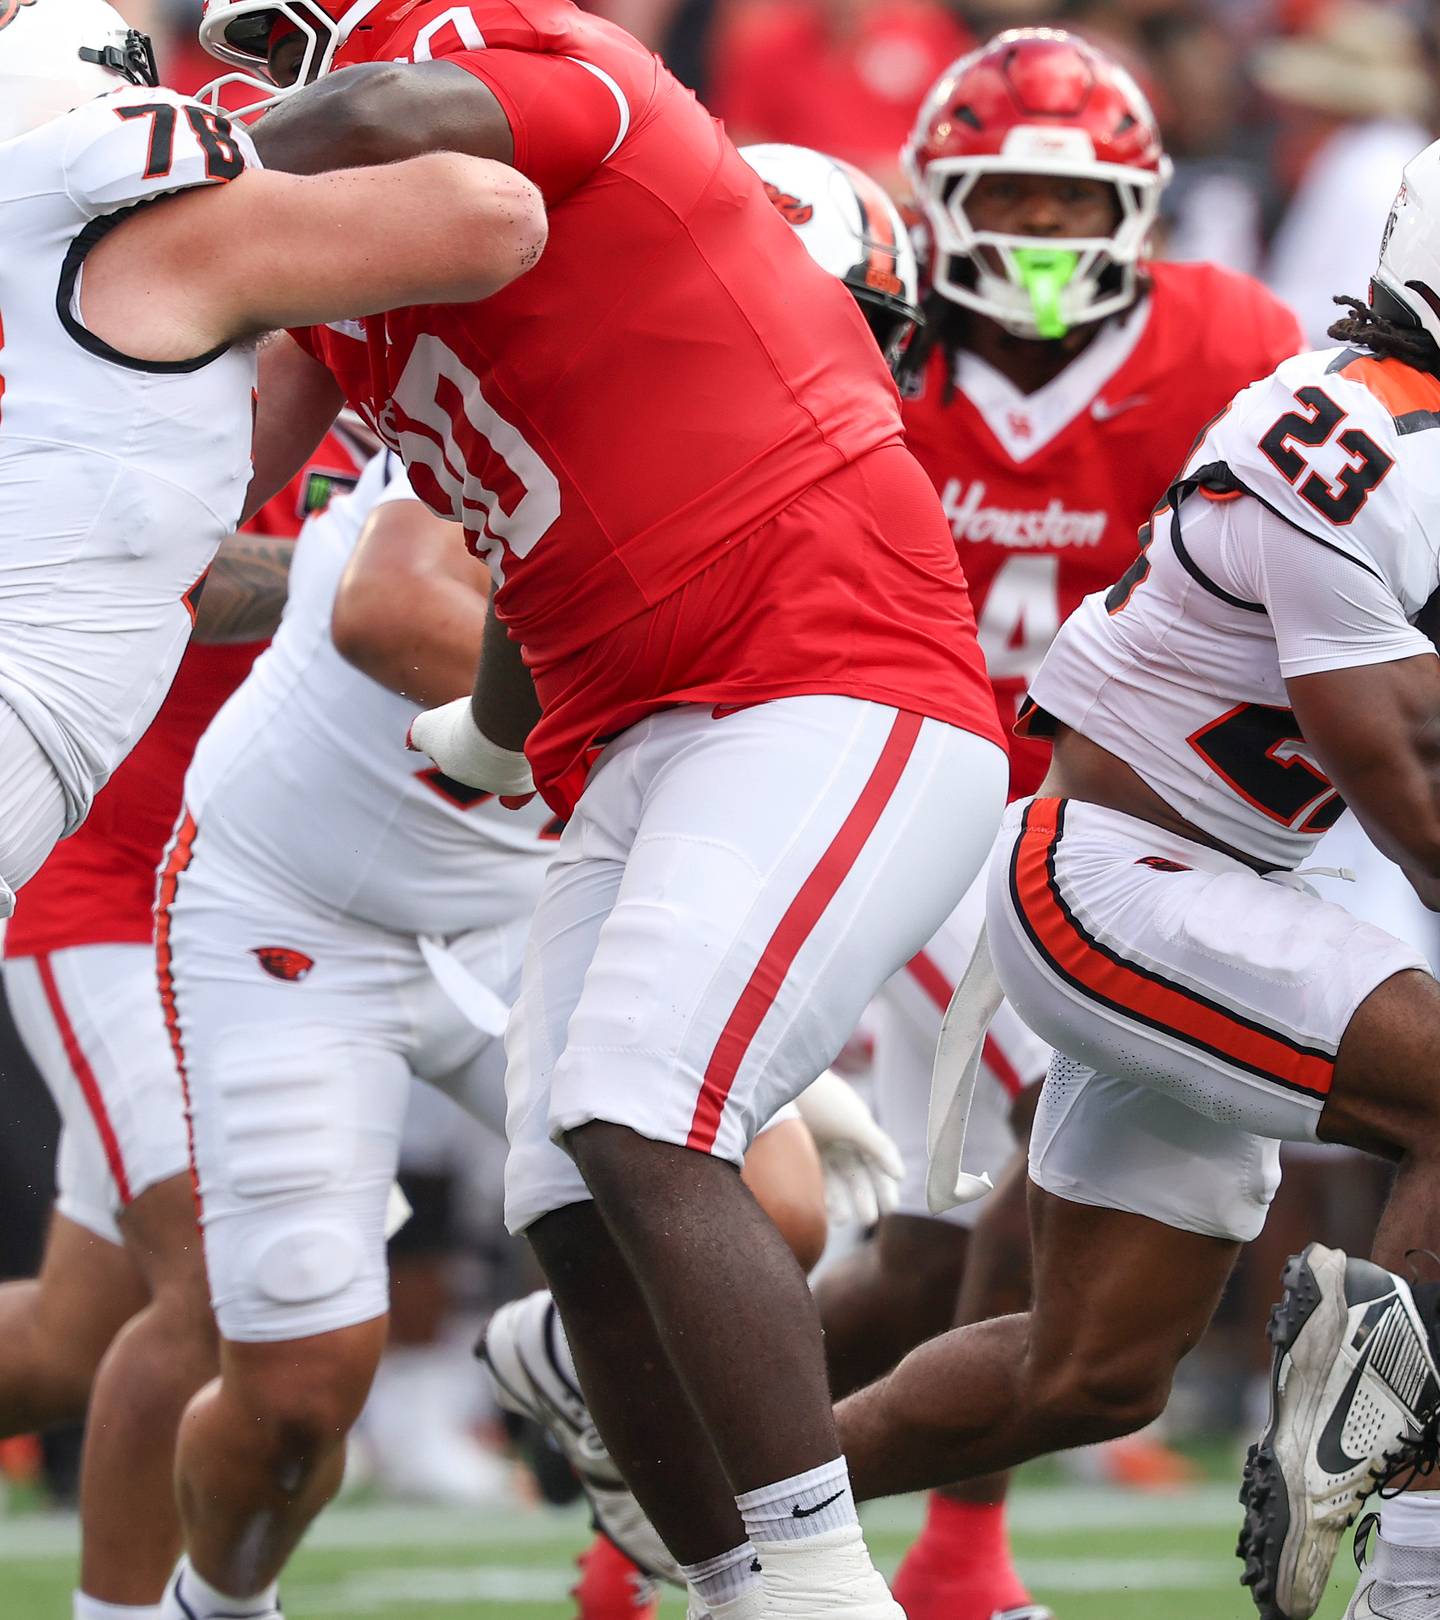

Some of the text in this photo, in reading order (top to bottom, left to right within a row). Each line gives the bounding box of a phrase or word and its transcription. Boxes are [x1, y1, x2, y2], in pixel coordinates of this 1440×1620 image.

[112, 103, 245, 184] 78
[1258, 386, 1395, 525] 23
[942, 478, 1107, 549] Houston
[977, 553, 1062, 680] 4
